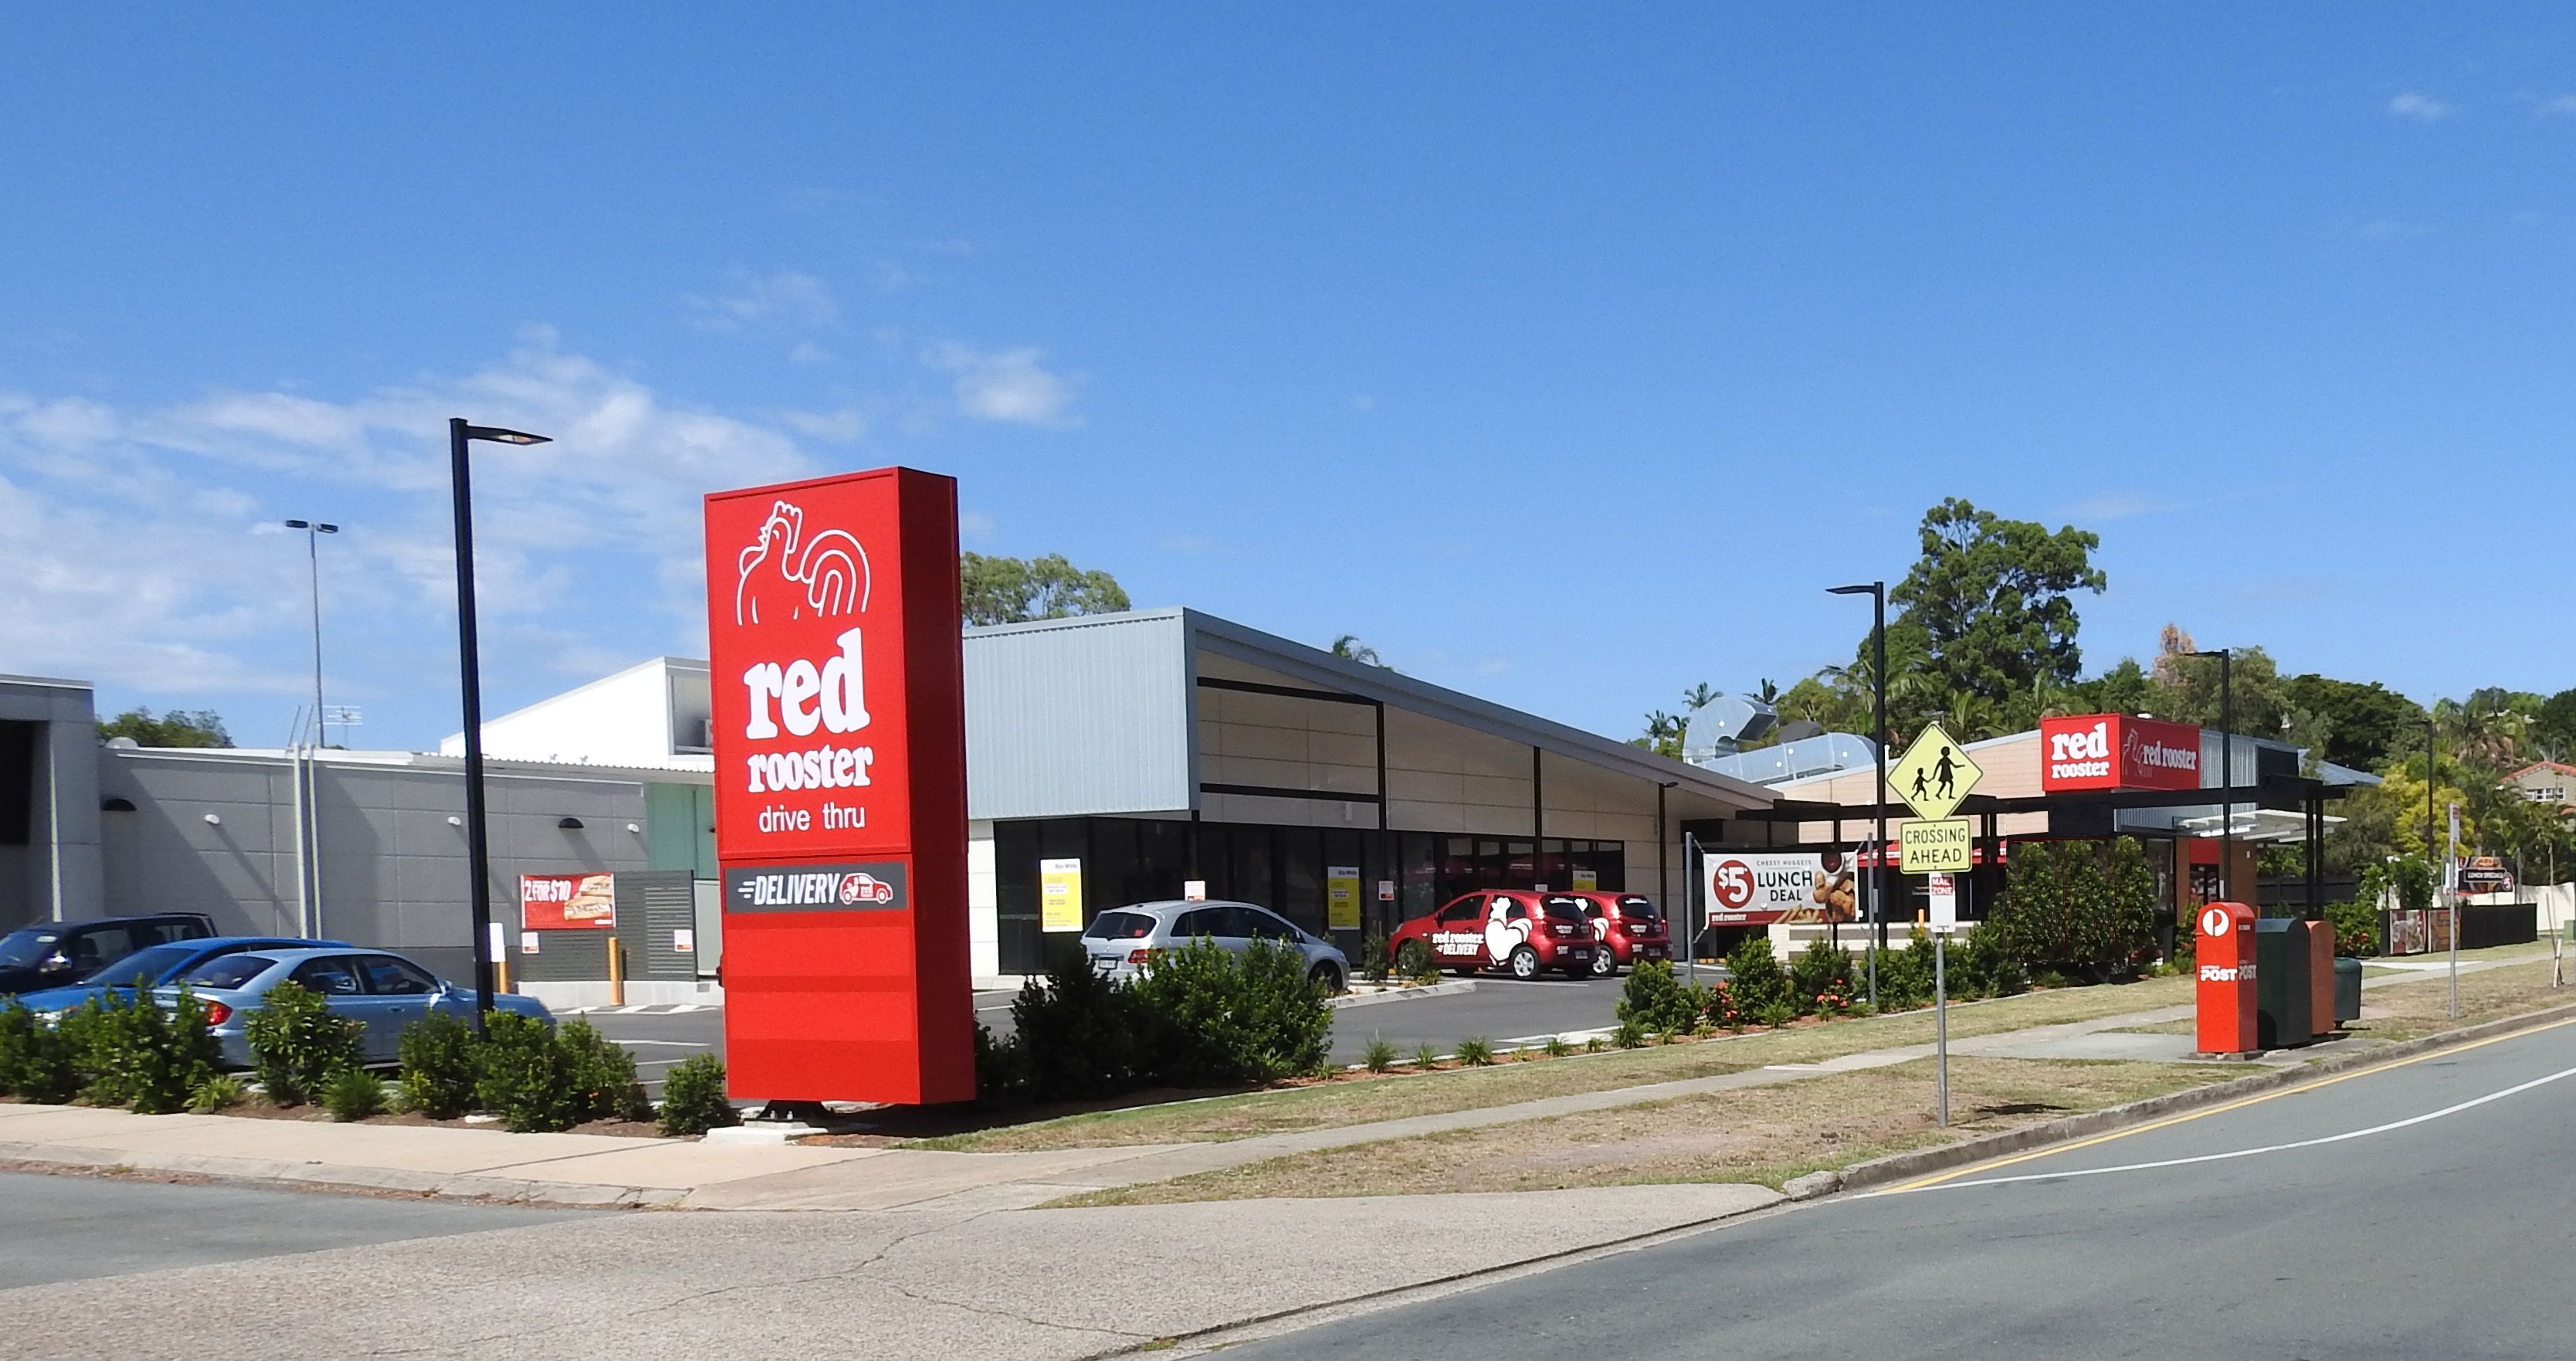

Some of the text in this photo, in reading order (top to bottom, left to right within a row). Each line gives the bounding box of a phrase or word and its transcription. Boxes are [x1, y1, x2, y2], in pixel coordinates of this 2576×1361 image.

[744, 627, 871, 740] red
[2051, 722, 2109, 761] red
[2144, 740, 2197, 771] red rooster
[747, 744, 874, 793] rooster
[2052, 761, 2110, 779] rooster
[759, 802, 865, 833] drive thru
[1905, 828, 1966, 844] CROSSING
[1910, 848, 1962, 864] AHEAD
[1757, 871, 1812, 888] LUNCH
[524, 881, 533, 901] 2
[754, 873, 840, 905] DELIVERY
[1771, 889, 1802, 901] DEAL
[1432, 930, 1484, 944] red rooster
[1443, 944, 1479, 955] DELIVERY
[2201, 969, 2238, 982] POST
[2239, 965, 2257, 980] POST
